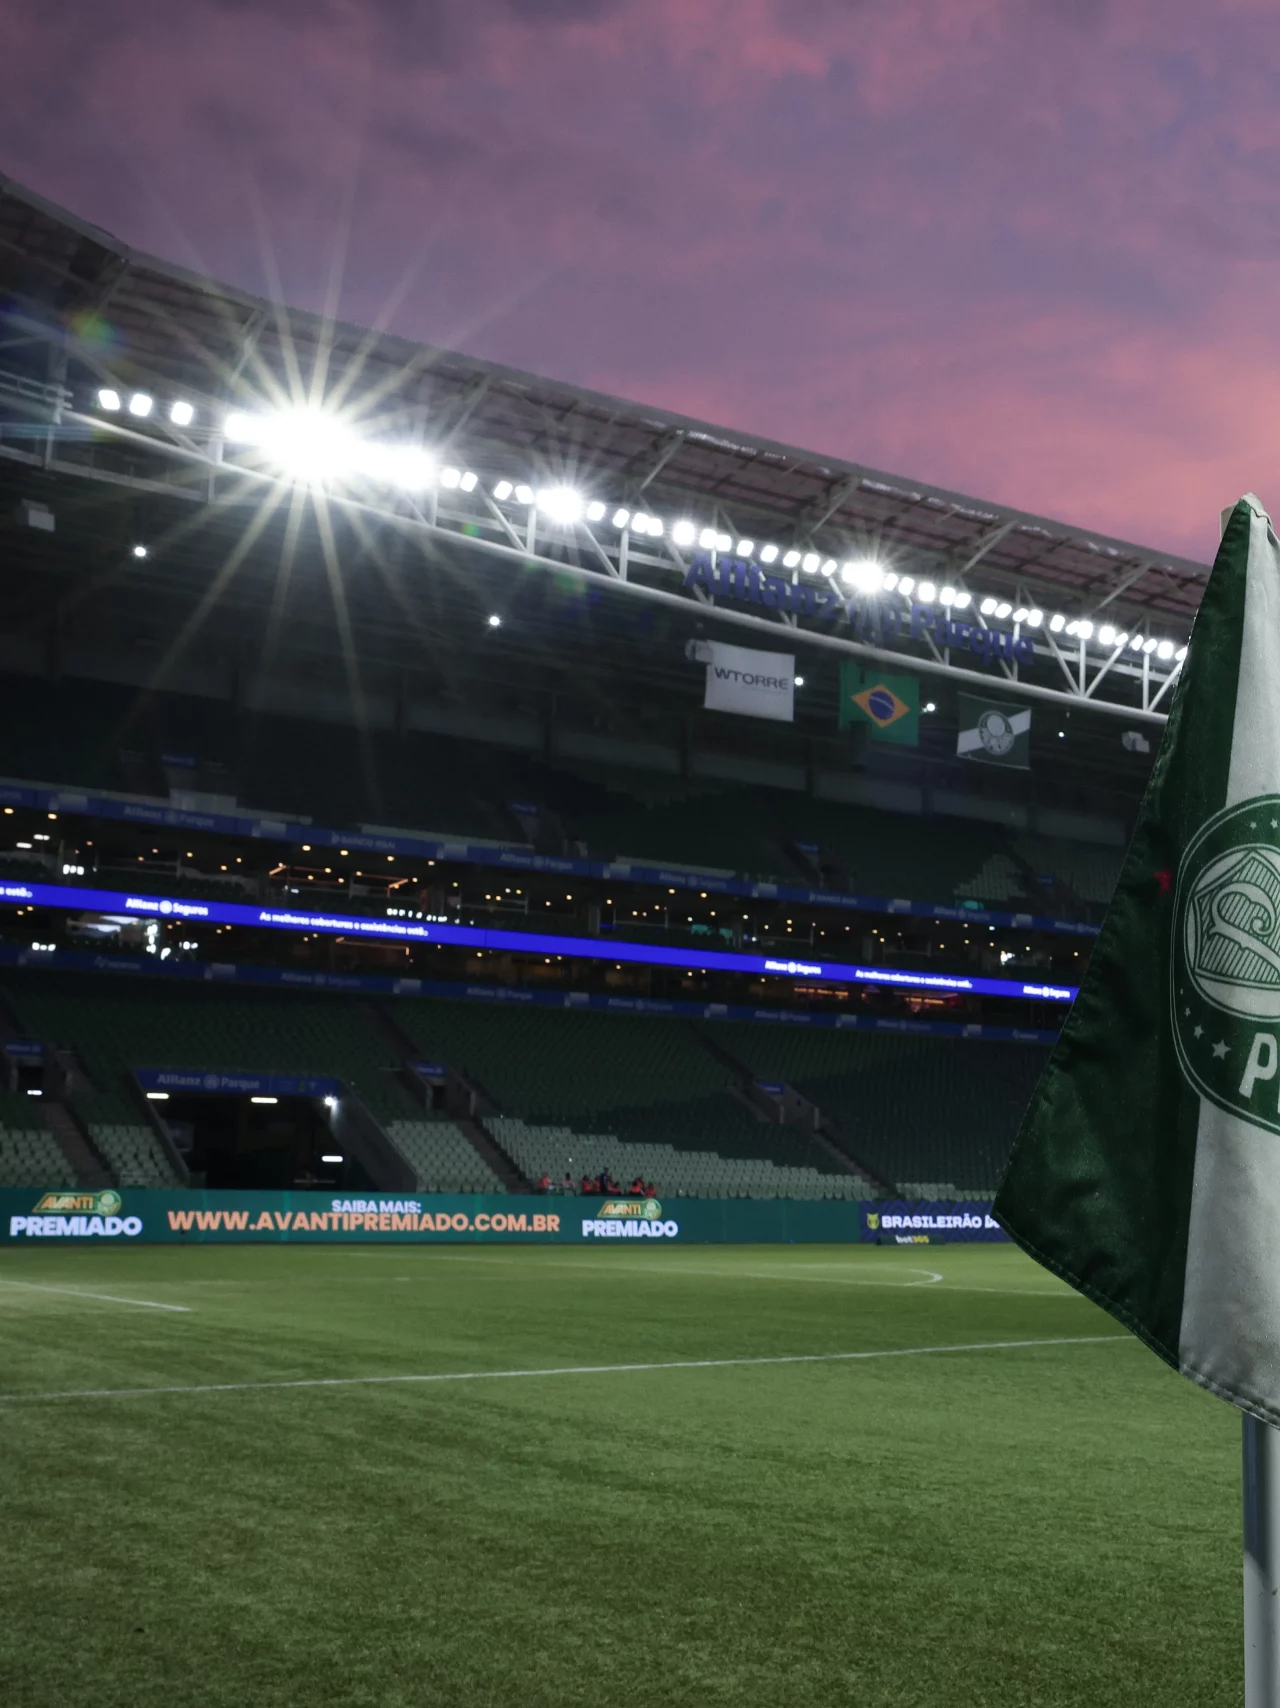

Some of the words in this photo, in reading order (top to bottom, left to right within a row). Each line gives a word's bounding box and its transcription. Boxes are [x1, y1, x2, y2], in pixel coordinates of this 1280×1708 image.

[684, 551, 839, 621] Allianz
[911, 603, 1034, 665] Parque
[714, 667, 789, 690] WTORRE
[126, 898, 160, 911] Allianz
[173, 902, 208, 916] Seguros
[157, 1074, 202, 1087] Allianz
[220, 1079, 261, 1091] Parque
[41, 1196, 94, 1209] AVANTI
[332, 1200, 379, 1213] SAIBA
[379, 1201, 421, 1213] MAIS:
[603, 1203, 642, 1215] AVANTI
[10, 1216, 143, 1236] PREMIADO
[168, 1211, 560, 1231] WWW.AVANTIPREMIADO.COM.BR
[582, 1219, 679, 1236] PREMIADO
[881, 1213, 983, 1229] BRASILEIRÃO
